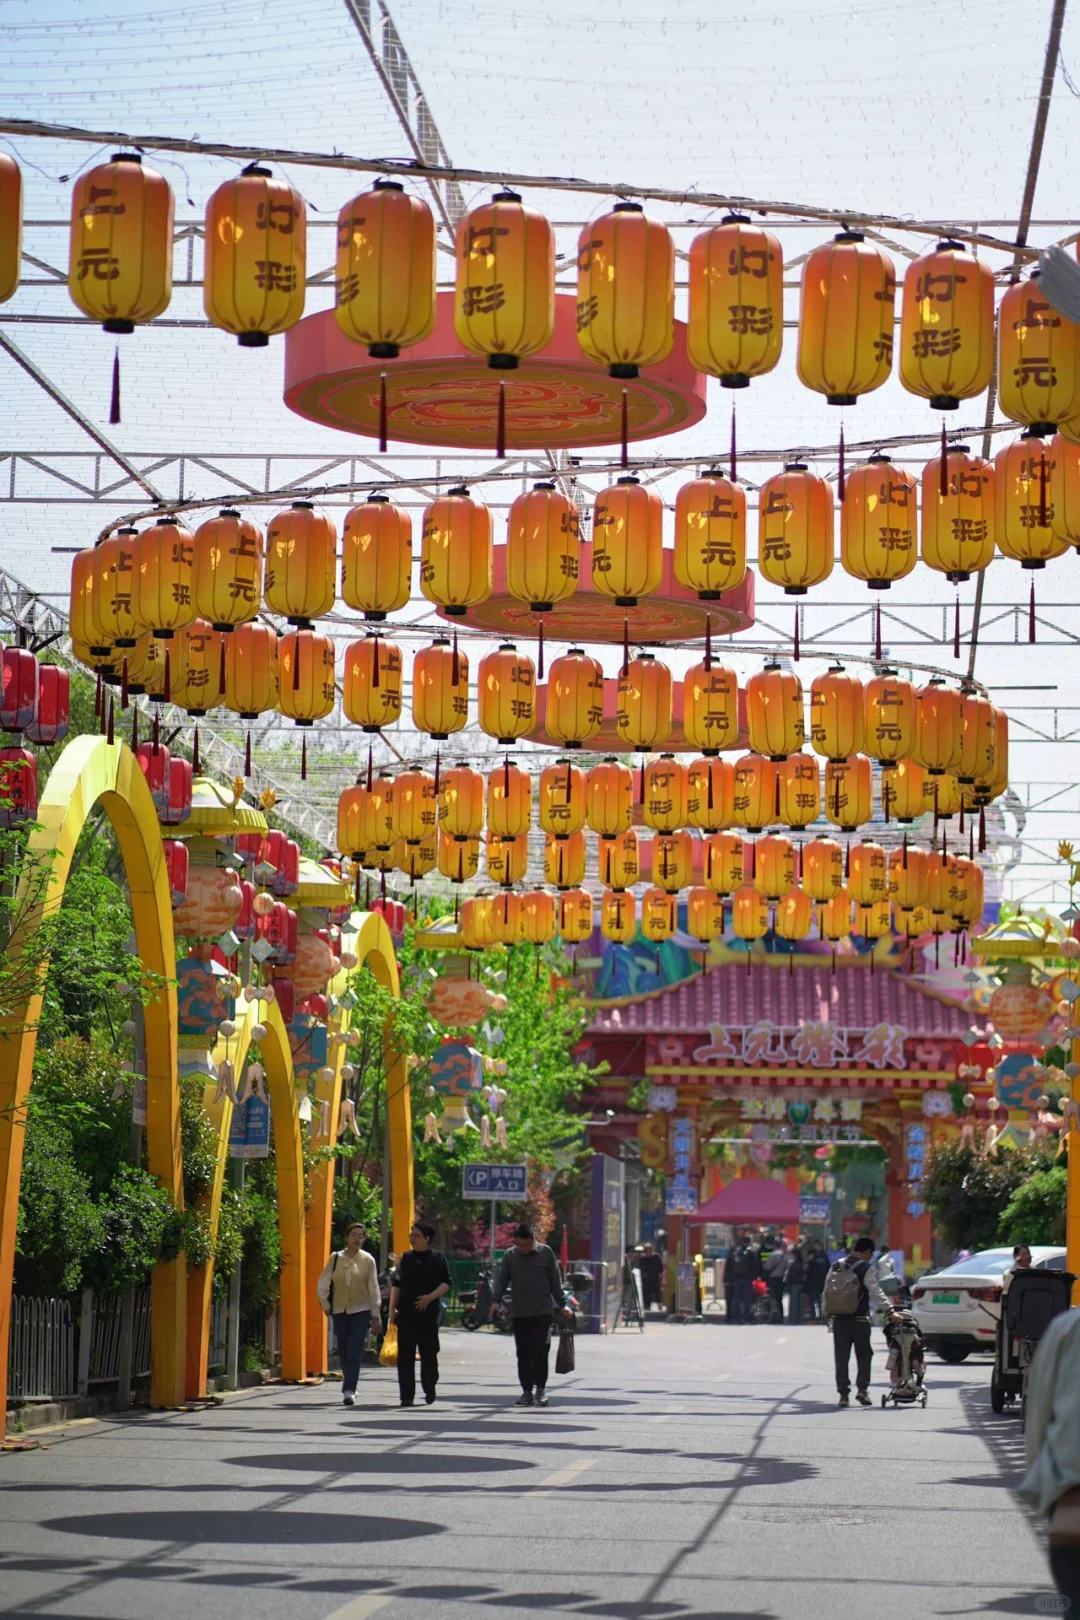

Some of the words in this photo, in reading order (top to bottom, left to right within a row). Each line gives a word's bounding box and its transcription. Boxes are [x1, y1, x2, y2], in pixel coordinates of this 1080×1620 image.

[77, 185, 126, 281] 上元
[254, 199, 299, 293] 灯彩
[728, 245, 774, 335] 灯彩
[912, 273, 967, 358] 灯彩
[1013, 299, 1061, 388] 上元
[701, 495, 738, 567] 上元
[763, 491, 794, 562] 上元
[879, 482, 912, 551] 灯彩
[951, 472, 989, 542] 灯彩
[228, 535, 256, 602] 上元
[380, 653, 401, 709] 上元
[511, 666, 533, 718] 灯彩
[703, 676, 730, 729] 上元
[876, 689, 904, 741] 上元
[548, 776, 572, 819] 上元
[649, 772, 675, 815] 灯彩
[796, 764, 817, 808] 灯彩
[476, 1171, 487, 1185] P
[491, 1168, 523, 1178] 停车场
[495, 1180, 518, 1190] 入口
